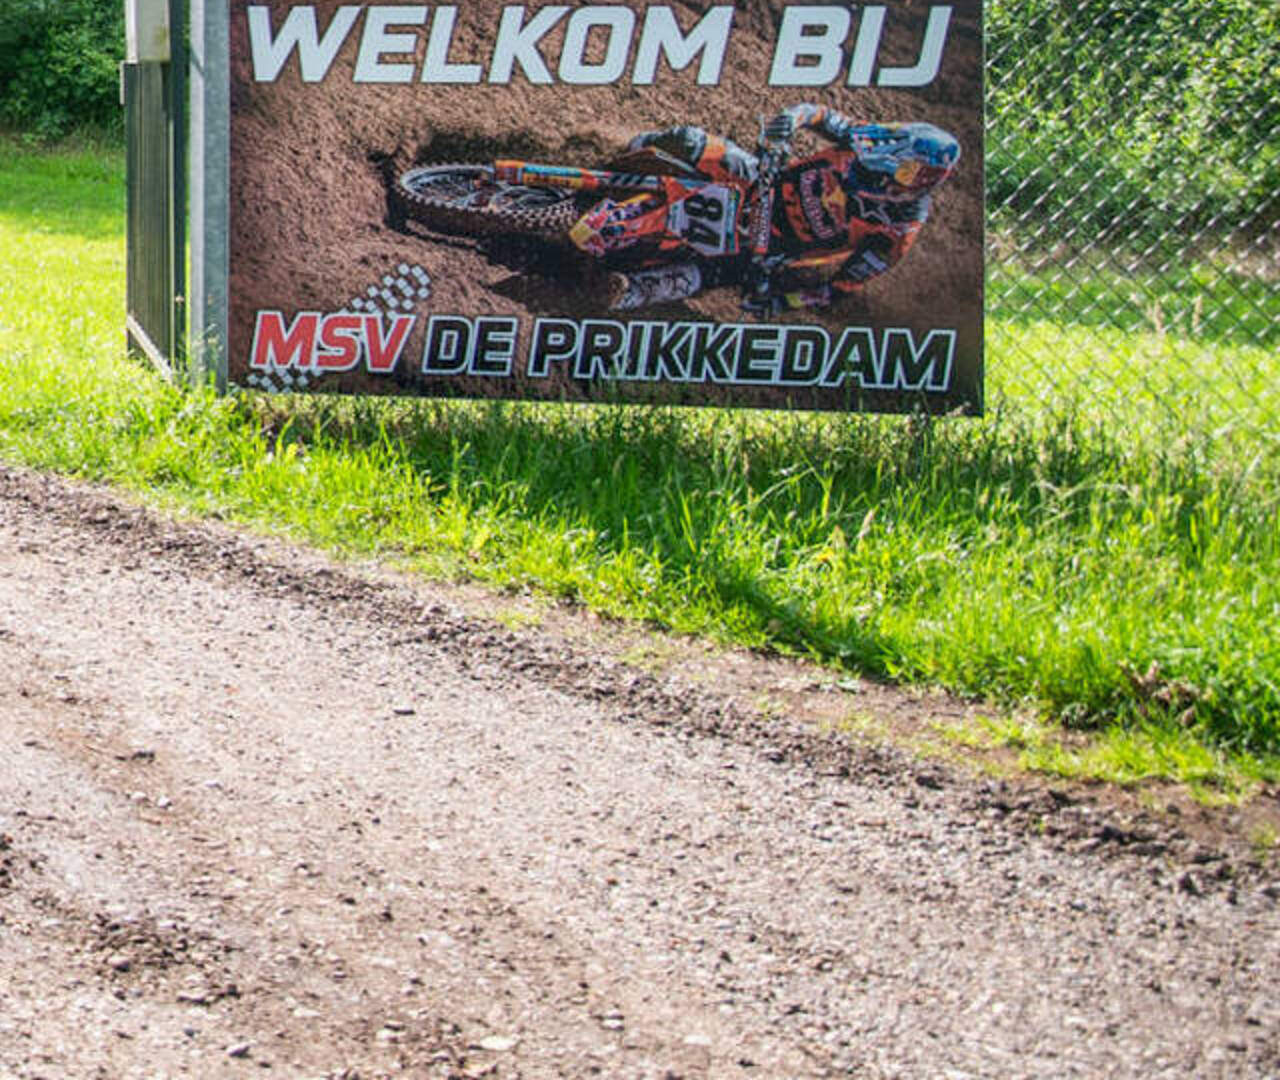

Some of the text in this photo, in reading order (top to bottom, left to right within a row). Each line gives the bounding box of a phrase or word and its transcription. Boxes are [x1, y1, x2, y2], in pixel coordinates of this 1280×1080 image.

[247, 6, 952, 87] WELKOM BIJ
[252, 312, 955, 390] MSV DE PRIKKEDAM
